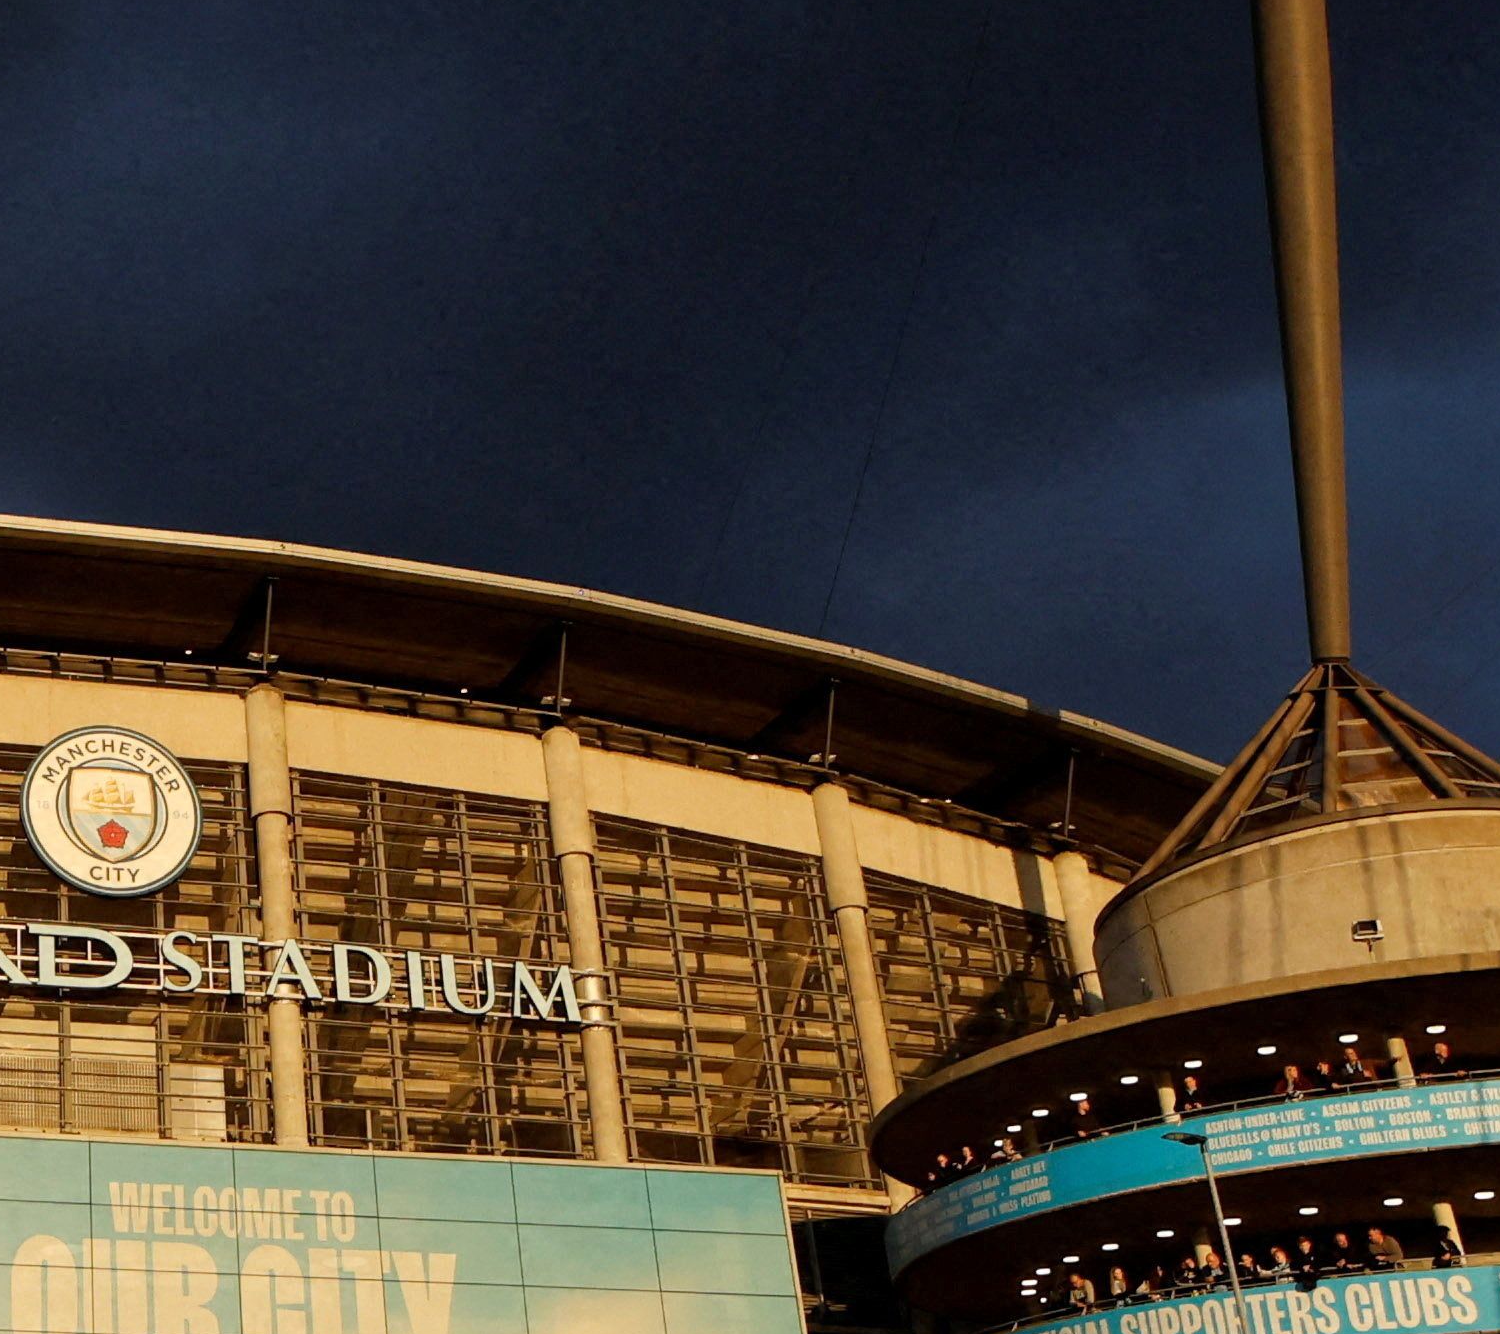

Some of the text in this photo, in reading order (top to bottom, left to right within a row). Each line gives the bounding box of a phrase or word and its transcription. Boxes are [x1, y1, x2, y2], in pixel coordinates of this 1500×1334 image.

[42, 739, 180, 793] MANCHESTER
[90, 866, 141, 883] CITY
[162, 929, 583, 1023] STADIUM
[1430, 1091, 1468, 1106] ASTLEY
[1334, 1116, 1375, 1133] BOLTON
[1389, 1109, 1433, 1127] BOSTON
[1208, 1130, 1261, 1152] BLUEBELLS
[1413, 1125, 1448, 1140] BLUES
[1211, 1148, 1253, 1167] CHICAGO
[109, 1181, 356, 1243] WELCOME TO
[1343, 1274, 1478, 1332] CLUBS
